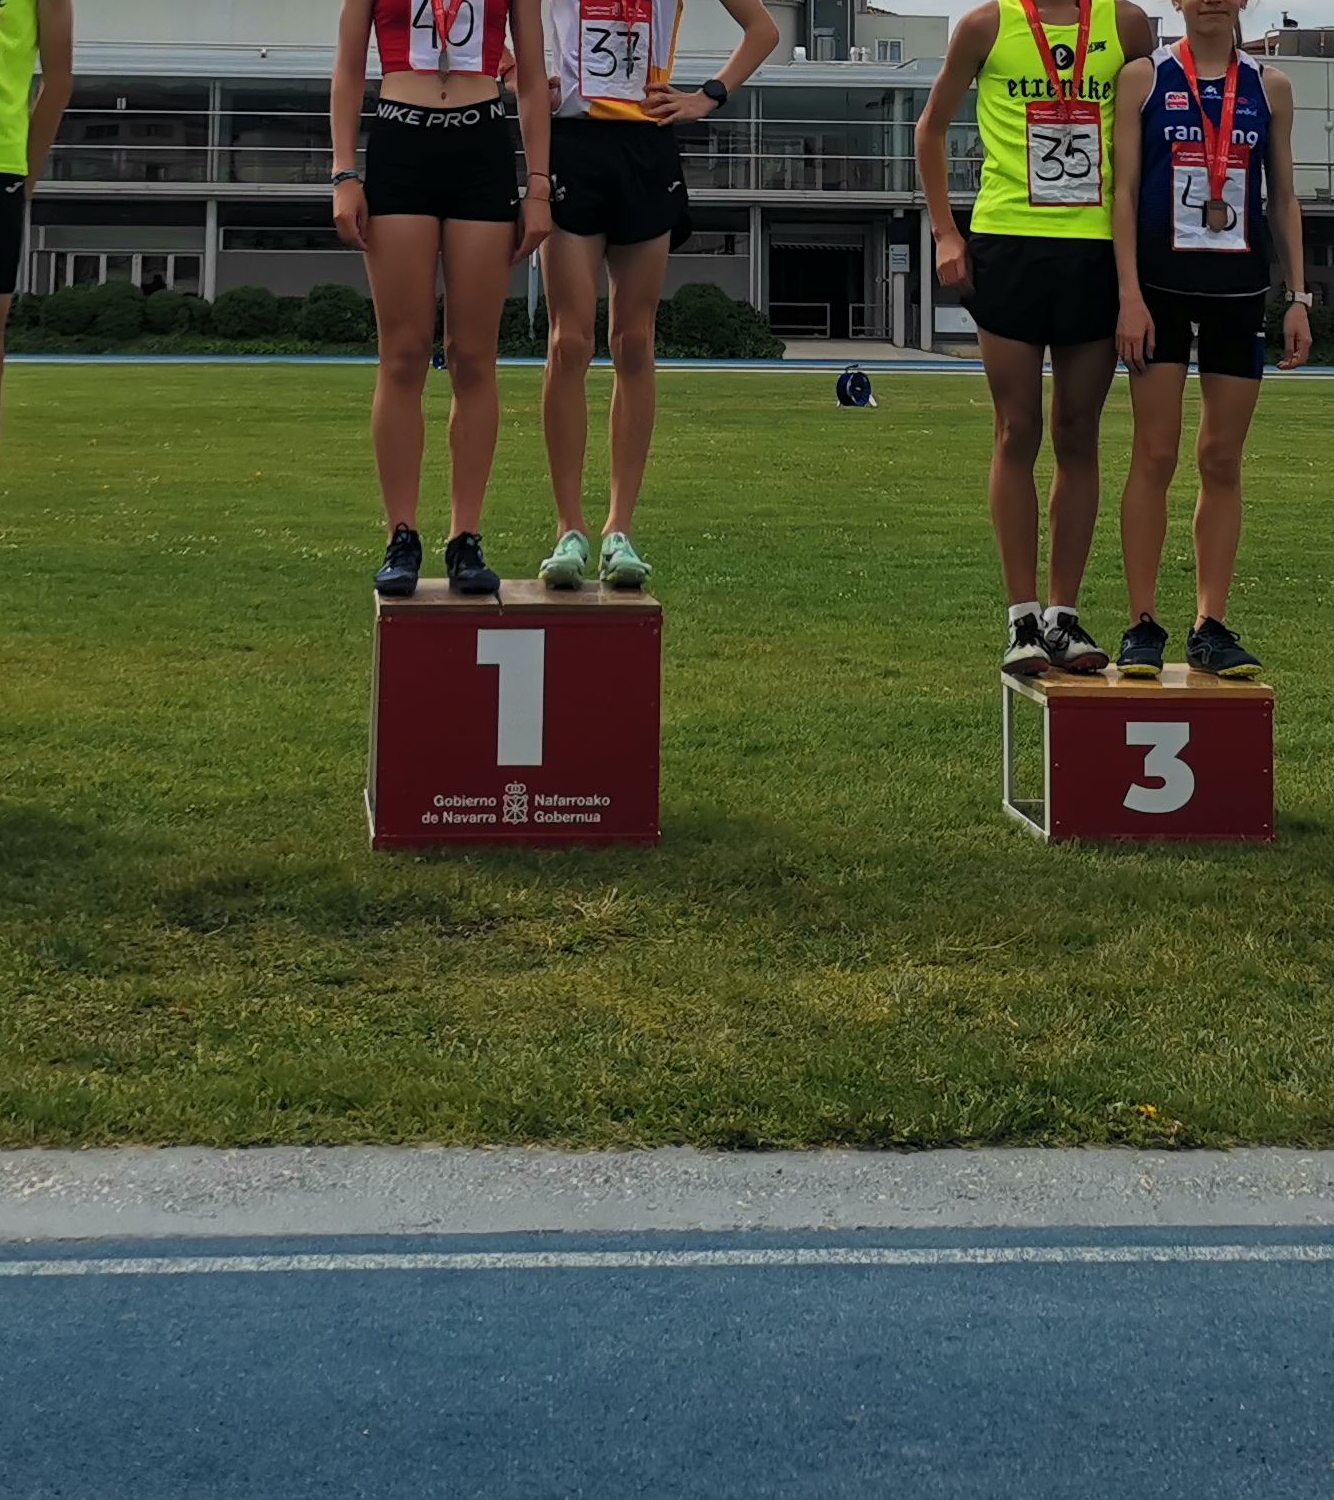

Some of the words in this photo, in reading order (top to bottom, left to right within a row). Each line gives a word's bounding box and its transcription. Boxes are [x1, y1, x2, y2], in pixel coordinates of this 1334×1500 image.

[585, 27, 641, 79] 37
[377, 103, 425, 126] NIKE
[426, 110, 481, 129] PRO
[1031, 132, 1091, 181] 35
[476, 628, 545, 766] 1
[1122, 721, 1195, 814] 3
[433, 794, 497, 807] Gobierno
[534, 794, 611, 807] Nafarroako
[421, 811, 439, 824] de
[442, 811, 497, 824] Navarra
[534, 811, 601, 823] Gobernua
